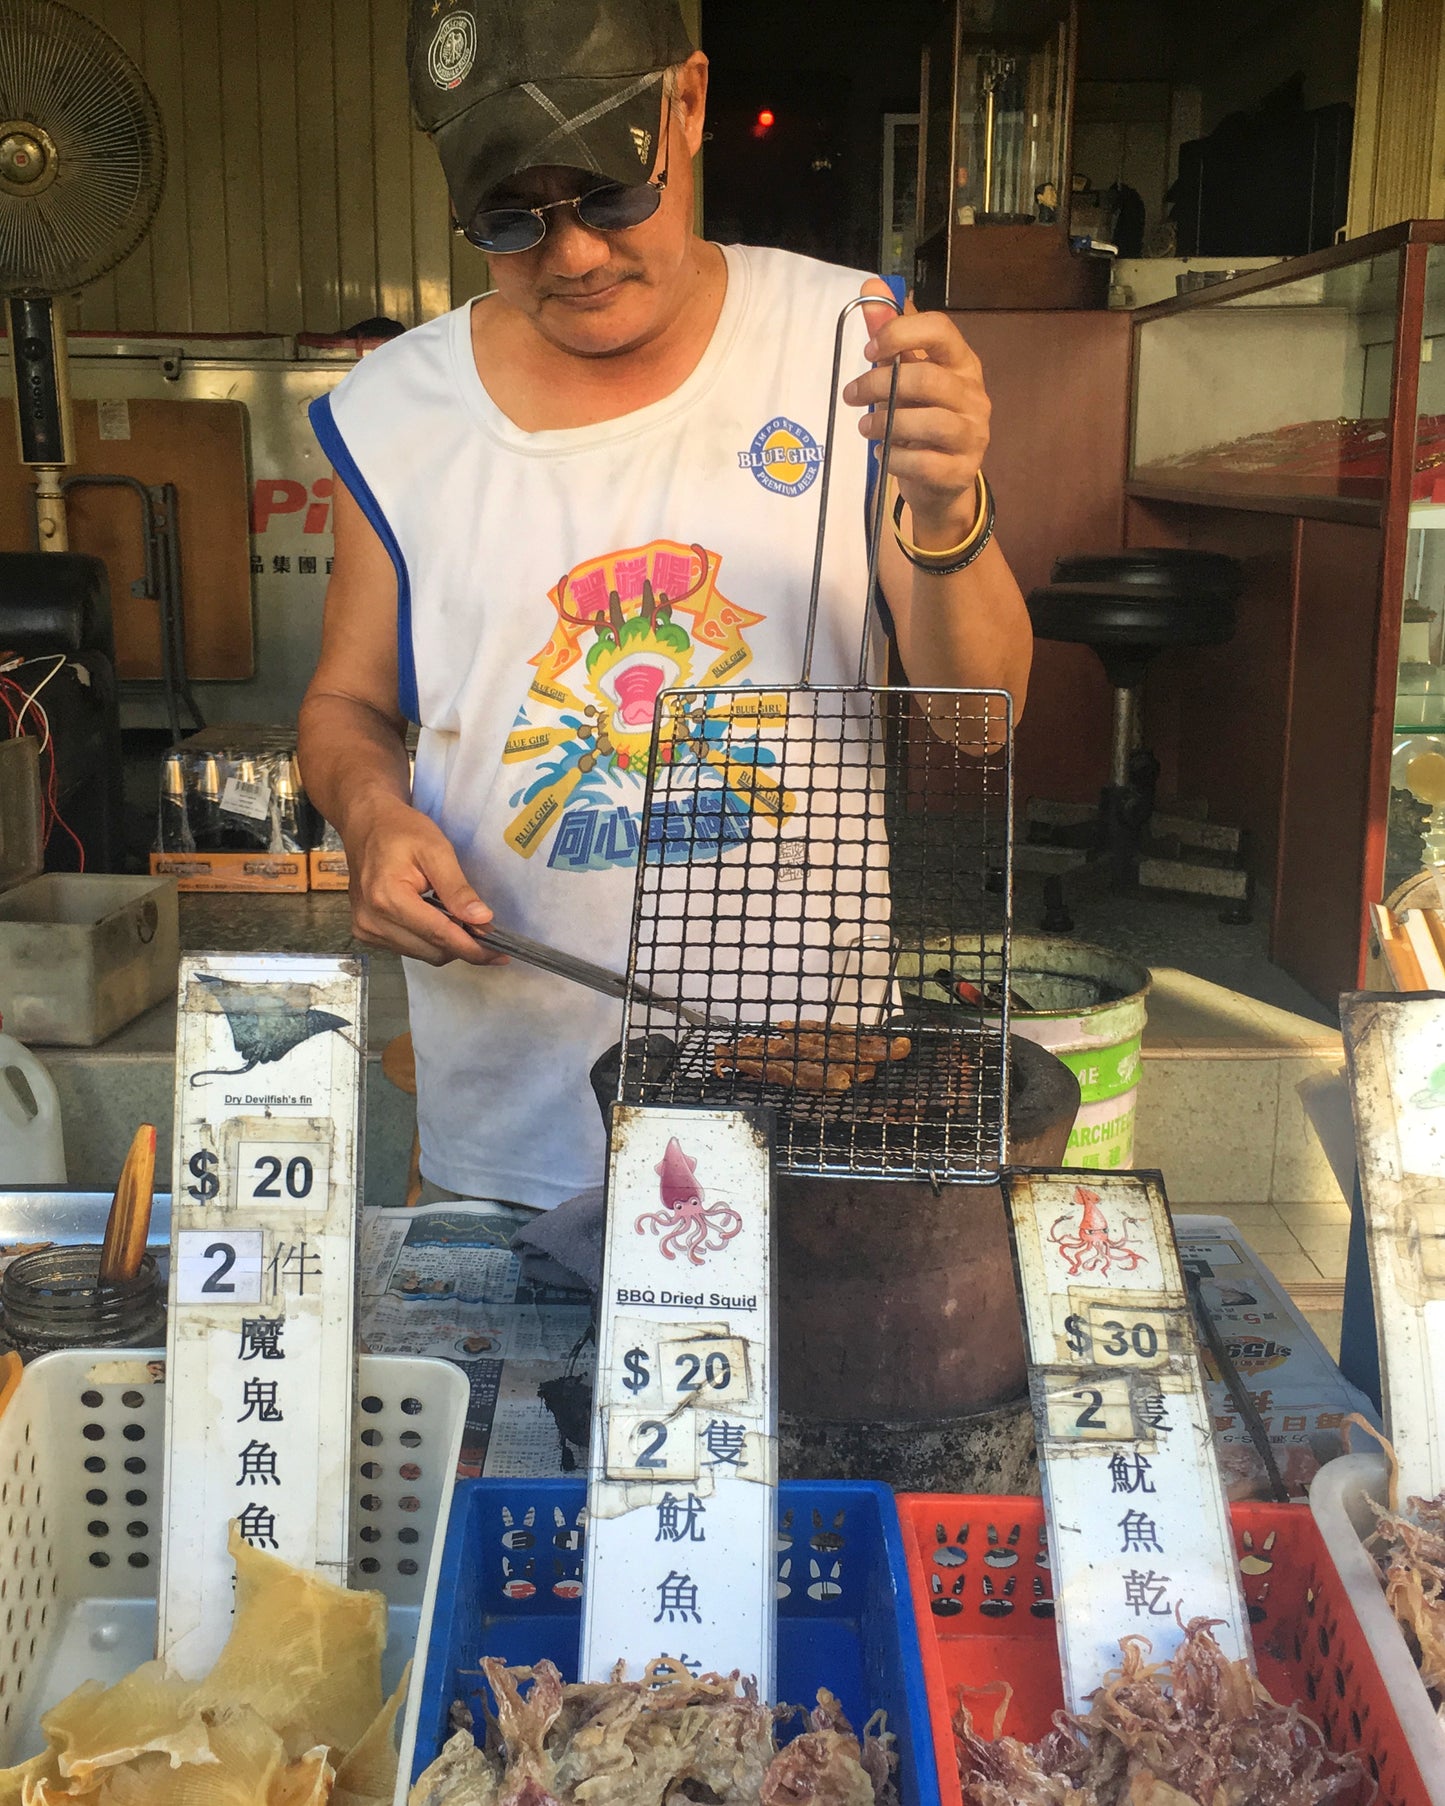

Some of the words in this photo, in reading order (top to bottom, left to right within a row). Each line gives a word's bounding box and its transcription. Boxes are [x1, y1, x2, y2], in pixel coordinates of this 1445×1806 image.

[754, 420, 810, 448] IMPORTED
[738, 448, 786, 468] BLUE
[757, 471, 798, 495] PREMIUM
[797, 466, 817, 492] BEER
[250, 478, 334, 534] Pi
[735, 705, 757, 714] BLUE
[529, 733, 549, 745] GIRL
[515, 820, 535, 844] BLUE
[535, 798, 556, 823] GIRL
[225, 1095, 242, 1104] Dry
[245, 1095, 297, 1104] Devilfish's
[300, 1095, 312, 1104] fin
[1066, 1110, 1136, 1149] ARCHITE
[187, 1148, 219, 1206] $
[252, 1155, 313, 1199] 20
[201, 1242, 236, 1293] 2
[267, 1241, 323, 1296] 件
[617, 1289, 655, 1304] BBQ
[661, 1291, 704, 1305] Dried
[709, 1293, 757, 1308] Squid
[1064, 1313, 1094, 1357] $
[1103, 1321, 1158, 1358] 30
[622, 1347, 650, 1395] $
[675, 1352, 731, 1392] 20
[1073, 1388, 1106, 1429] 2
[229, 1315, 285, 1613] 魔鬼魚魚
[635, 1420, 668, 1468] 2
[700, 1419, 749, 1467] 隻
[1107, 1451, 1172, 1617] 魷魚乾
